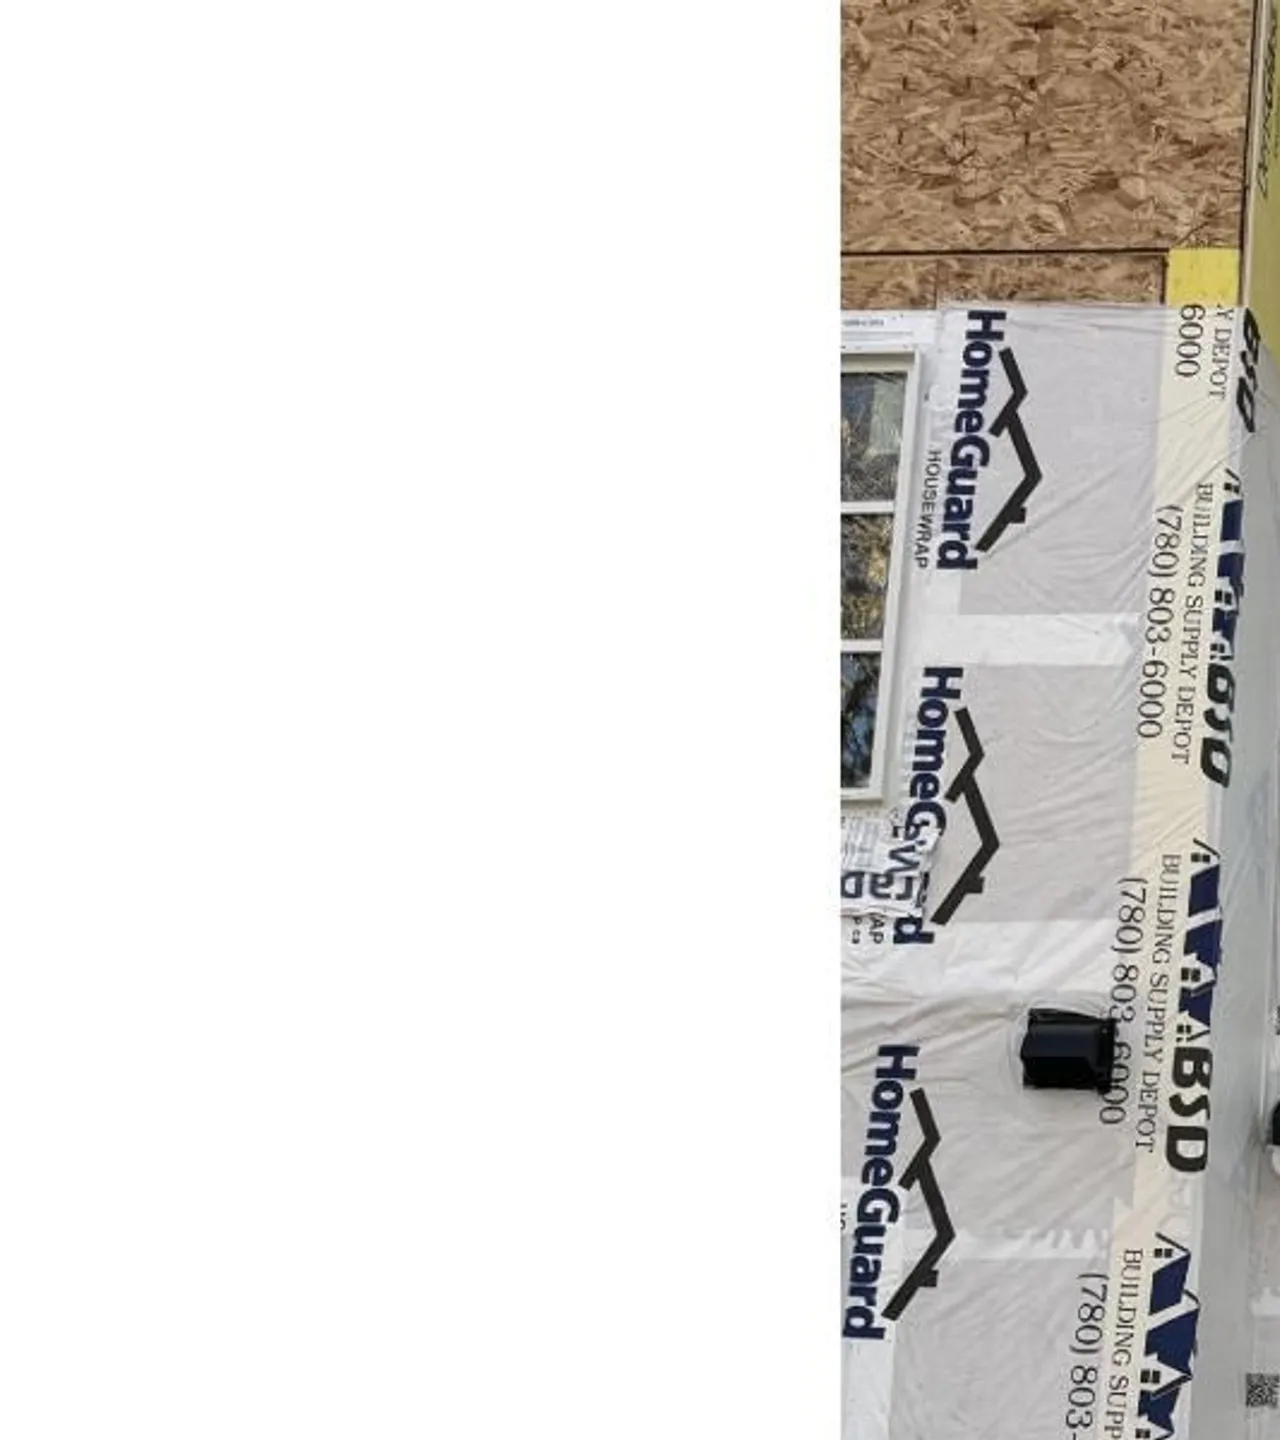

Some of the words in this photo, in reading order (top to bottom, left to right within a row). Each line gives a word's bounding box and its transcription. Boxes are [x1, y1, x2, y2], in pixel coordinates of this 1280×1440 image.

[936, 310, 1007, 571] HomeGuard
[915, 451, 941, 569] HOUSEWRAP
[1147, 504, 1185, 578] (780)
[1138, 587, 1176, 739] 803-6000
[1177, 594, 1204, 681] SUPPLY
[1171, 684, 1196, 766] DEPOT
[1112, 876, 1149, 954] (780)
[1143, 968, 1171, 1062] SUPPLY
[1136, 1067, 1162, 1154] DEPOT
[1165, 1047, 1214, 1174] BSD
[842, 1044, 920, 1341] HomeGuard
[1070, 1273, 1110, 1355] (780)
[1109, 1249, 1144, 1366] BUILDING
